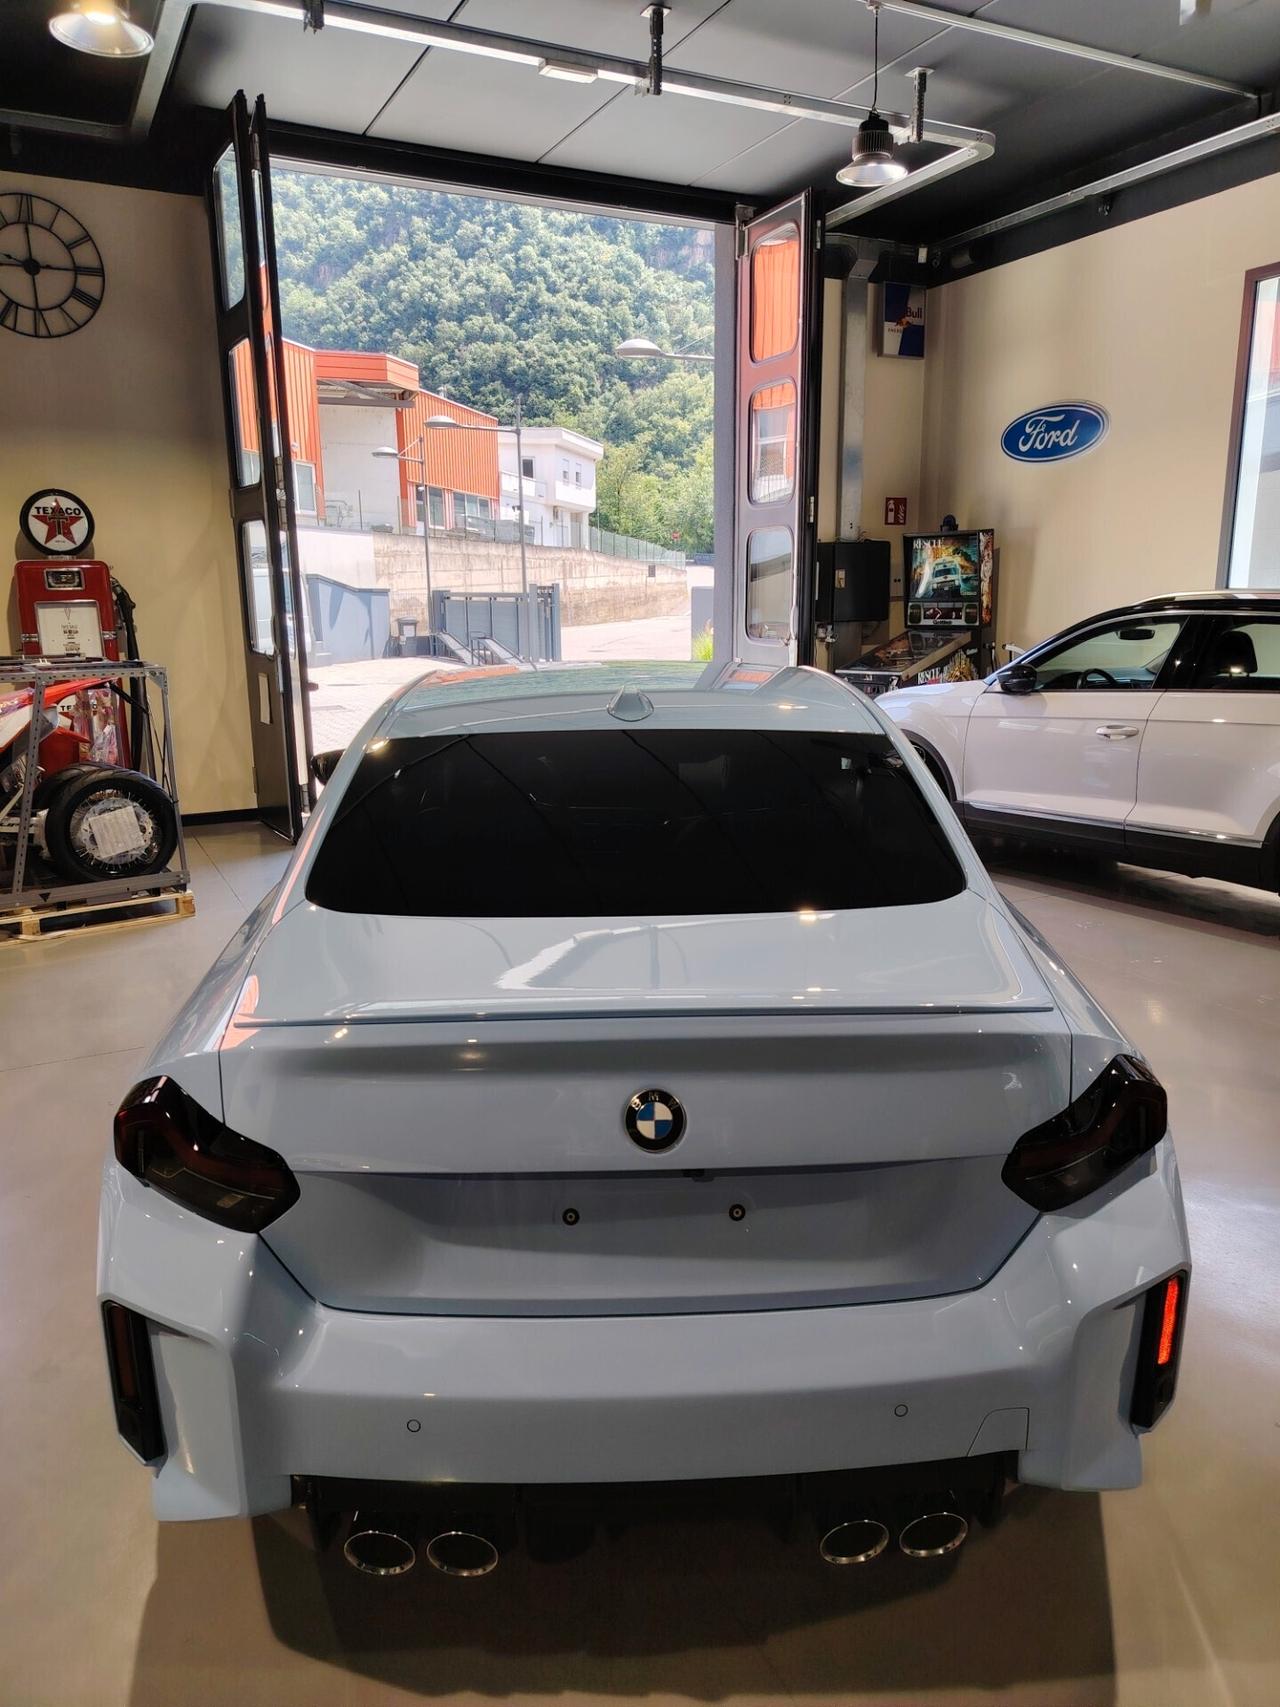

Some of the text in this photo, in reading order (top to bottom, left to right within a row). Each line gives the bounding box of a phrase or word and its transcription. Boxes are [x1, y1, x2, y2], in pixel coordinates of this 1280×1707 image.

[905, 307, 923, 319] Bull
[1018, 414, 1081, 453] Ford
[35, 506, 82, 517] TEXACO
